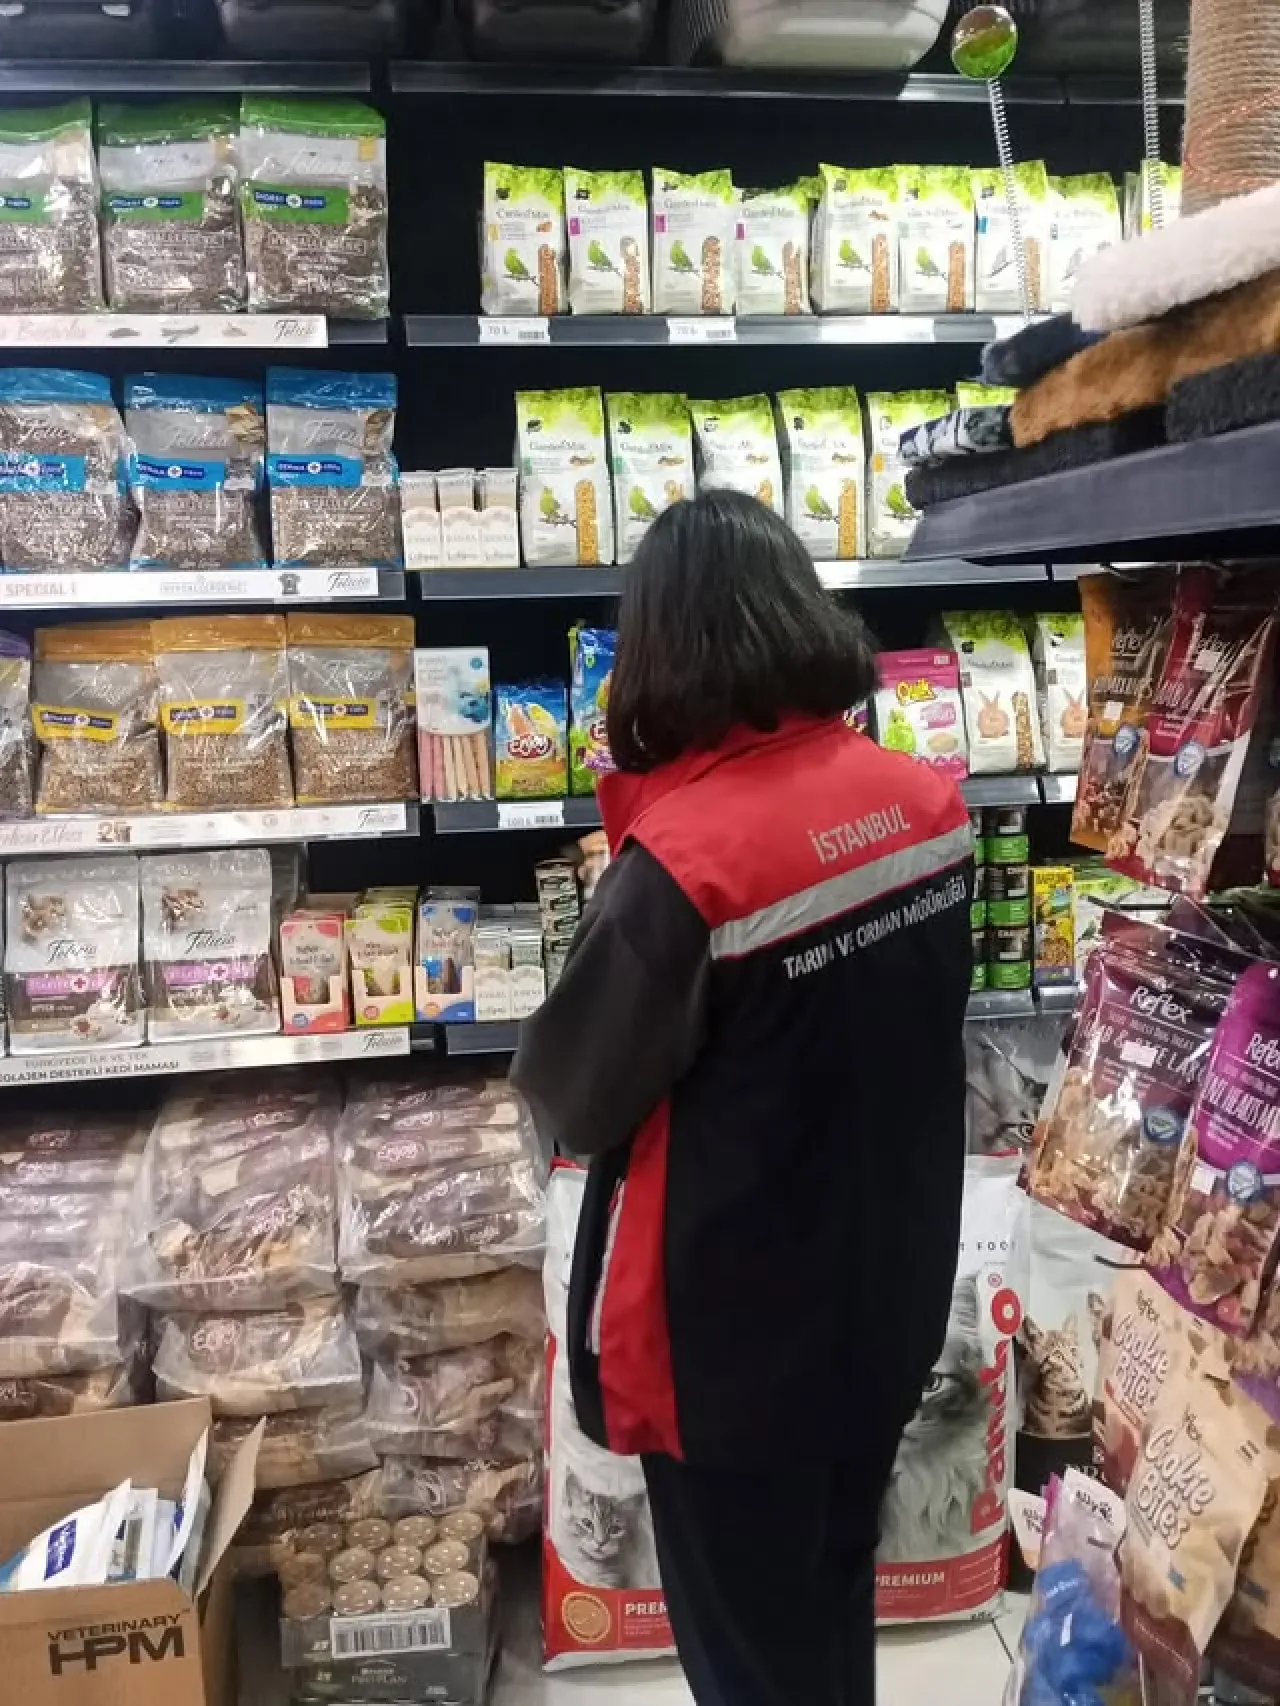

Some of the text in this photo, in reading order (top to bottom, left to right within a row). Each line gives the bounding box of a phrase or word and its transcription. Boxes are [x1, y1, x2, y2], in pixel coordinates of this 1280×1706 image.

[807, 803, 911, 865] İSTANBUL
[1130, 985, 1192, 1024] Reflex
[1113, 1312, 1169, 1382] Cookie
[1145, 1426, 1217, 1517] Cookie
[1138, 1472, 1190, 1550] Bites
[47, 1612, 181, 1642] VETERINARY
[48, 1626, 185, 1676] HPM
